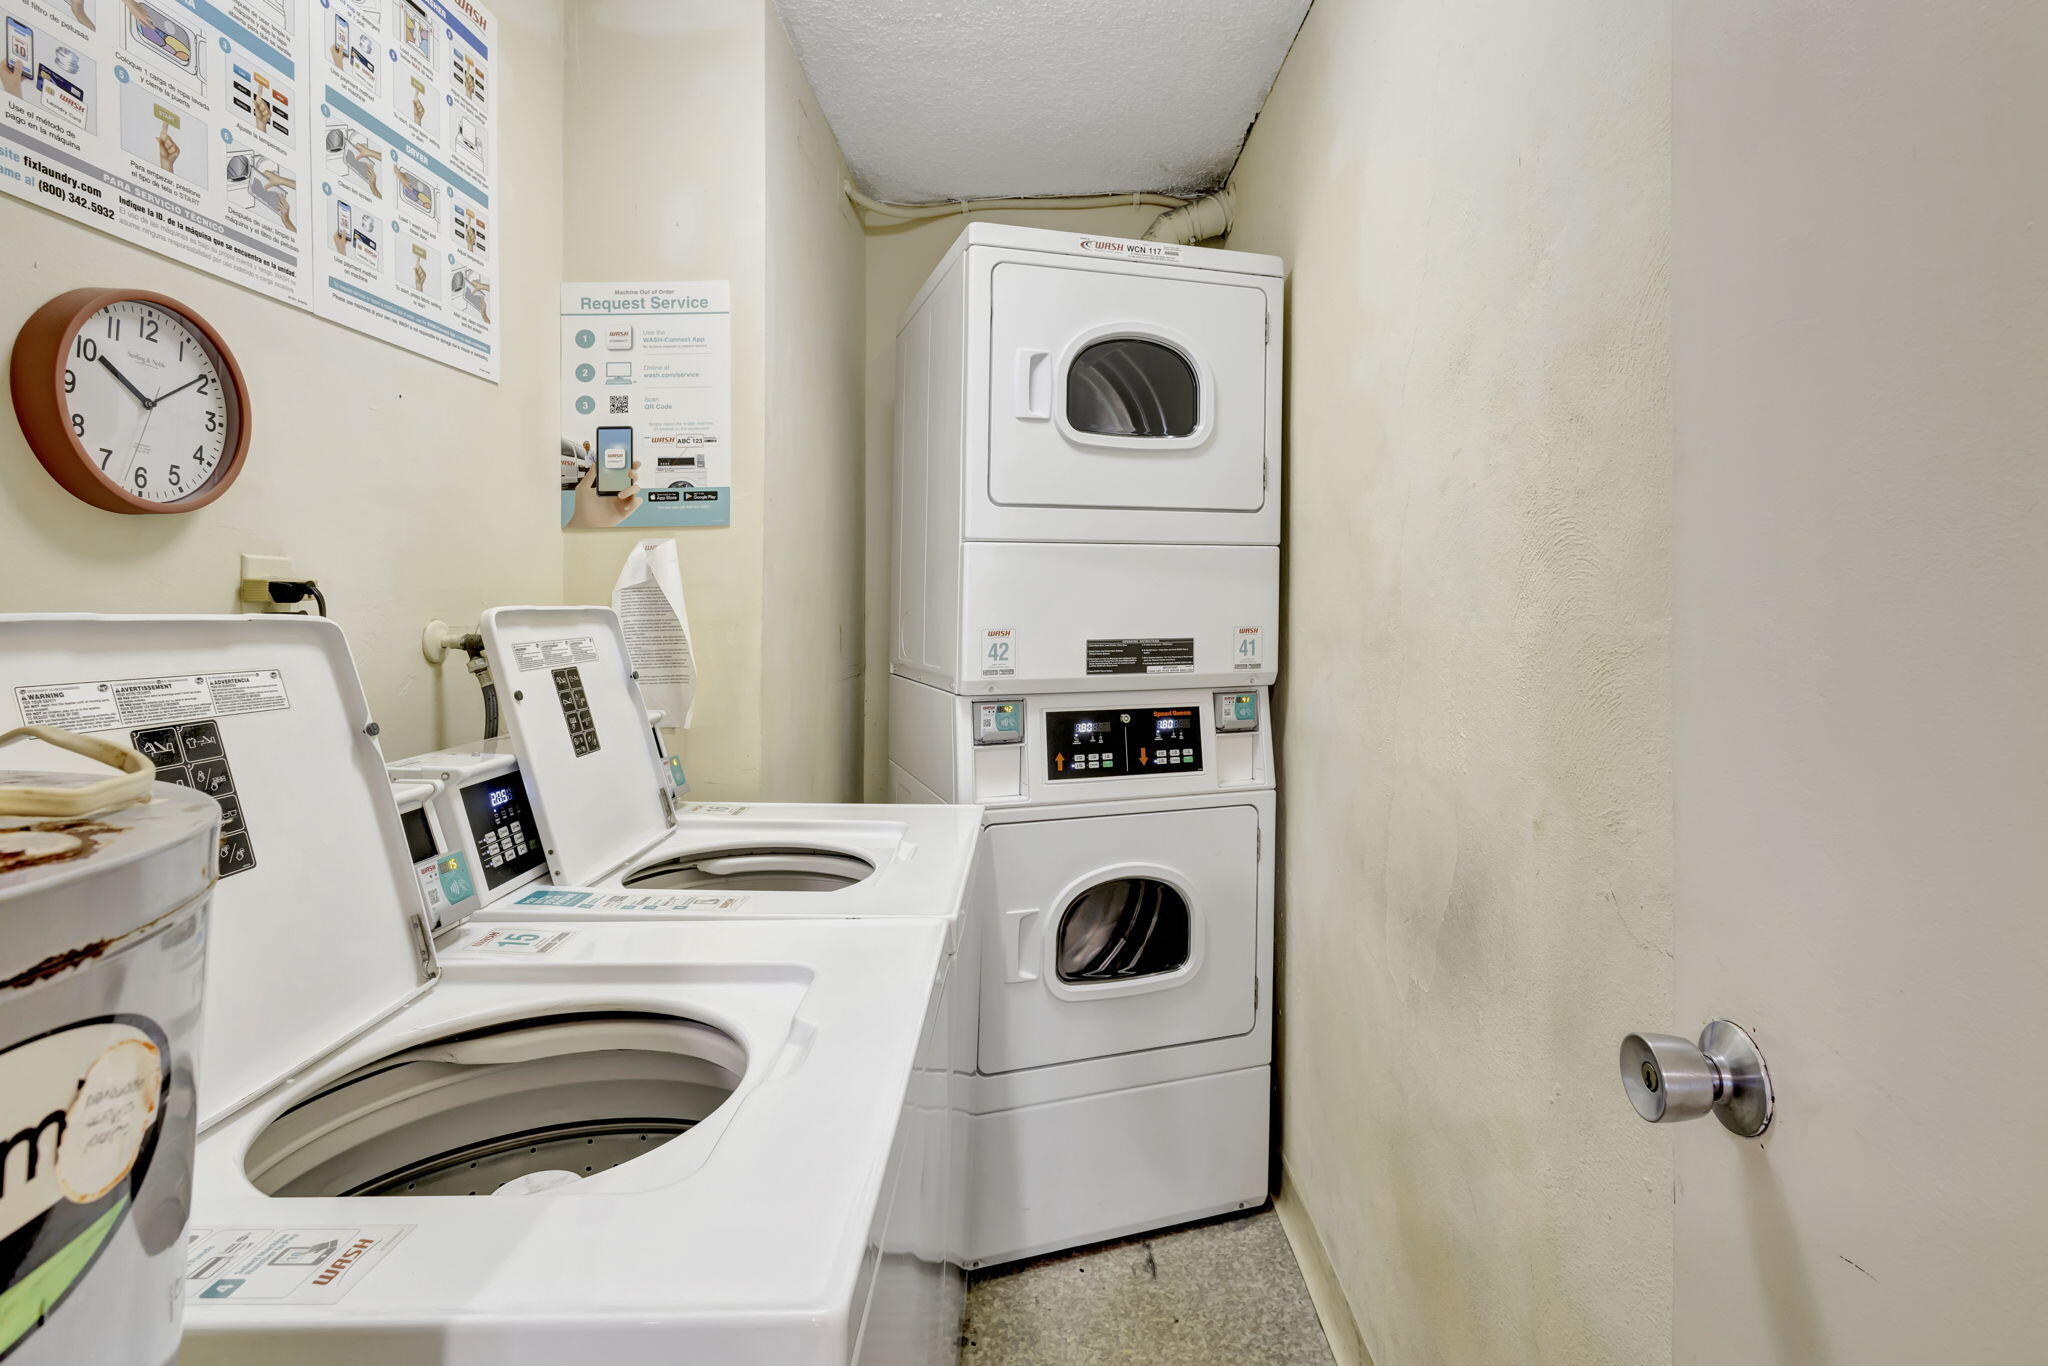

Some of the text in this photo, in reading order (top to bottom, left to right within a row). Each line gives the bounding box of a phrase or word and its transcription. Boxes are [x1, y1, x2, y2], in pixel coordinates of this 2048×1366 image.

[14, 44, 26, 58] 10
[115, 50, 142, 75] Coloque
[149, 72, 166, 88] carga
[167, 81, 175, 92] de
[177, 88, 189, 102] ropa
[59, 94, 85, 112] WASH
[140, 76, 190, 110] y cierre la puerta
[8, 101, 75, 139] Use el método de
[46, 98, 82, 124] Laundry Card
[5, 109, 80, 152] pago en la máquina
[405, 142, 428, 166] DRYER
[24, 155, 101, 199] fixlaundry.com
[130, 160, 145, 173] Para
[24, 174, 35, 187] al
[39, 179, 64, 201] (800)
[68, 192, 114, 220] 342.5932
[103, 173, 131, 192] PARA
[134, 187, 181, 215] SERVICIO
[131, 170, 137, 178] el
[138, 173, 150, 185] tipo
[151, 180, 159, 188] de
[161, 184, 172, 194] tela
[179, 192, 199, 206] START
[225, 214, 248, 230] máquina
[254, 227, 259, 235] el
[260, 230, 271, 240] filtro
[273, 236, 279, 244] de
[228, 206, 251, 224] Después
[254, 218, 260, 227] de
[261, 222, 273, 234] usar,
[119, 195, 296, 278] Indique la ID. de la máquina que se encuentra en la unidad.
[1095, 241, 1124, 251] WASH
[1126, 245, 1146, 253] WCN
[333, 255, 376, 280] Use payment method
[350, 270, 367, 283] machine
[581, 296, 709, 313] Request Service
[107, 316, 120, 341] 11
[140, 316, 159, 343] 12
[76, 334, 97, 362] 10
[179, 340, 184, 362] 1
[64, 370, 76, 393] 9
[582, 368, 588, 377] 2
[196, 374, 209, 396] 2
[72, 414, 84, 438] 8
[205, 411, 216, 432] 3
[99, 447, 113, 471] 7
[193, 445, 205, 466] 4
[134, 466, 148, 488] 6
[168, 464, 181, 486] 5
[988, 642, 1009, 661] 42
[1239, 639, 1255, 656] 41
[27, 692, 64, 700] WARNING
[120, 684, 172, 693] AVERTISSEMENT
[1153, 710, 1172, 718] Speed
[498, 934, 540, 947] 15
[312, 1238, 374, 1286] WASH
[216, 1284, 234, 1293] 4
